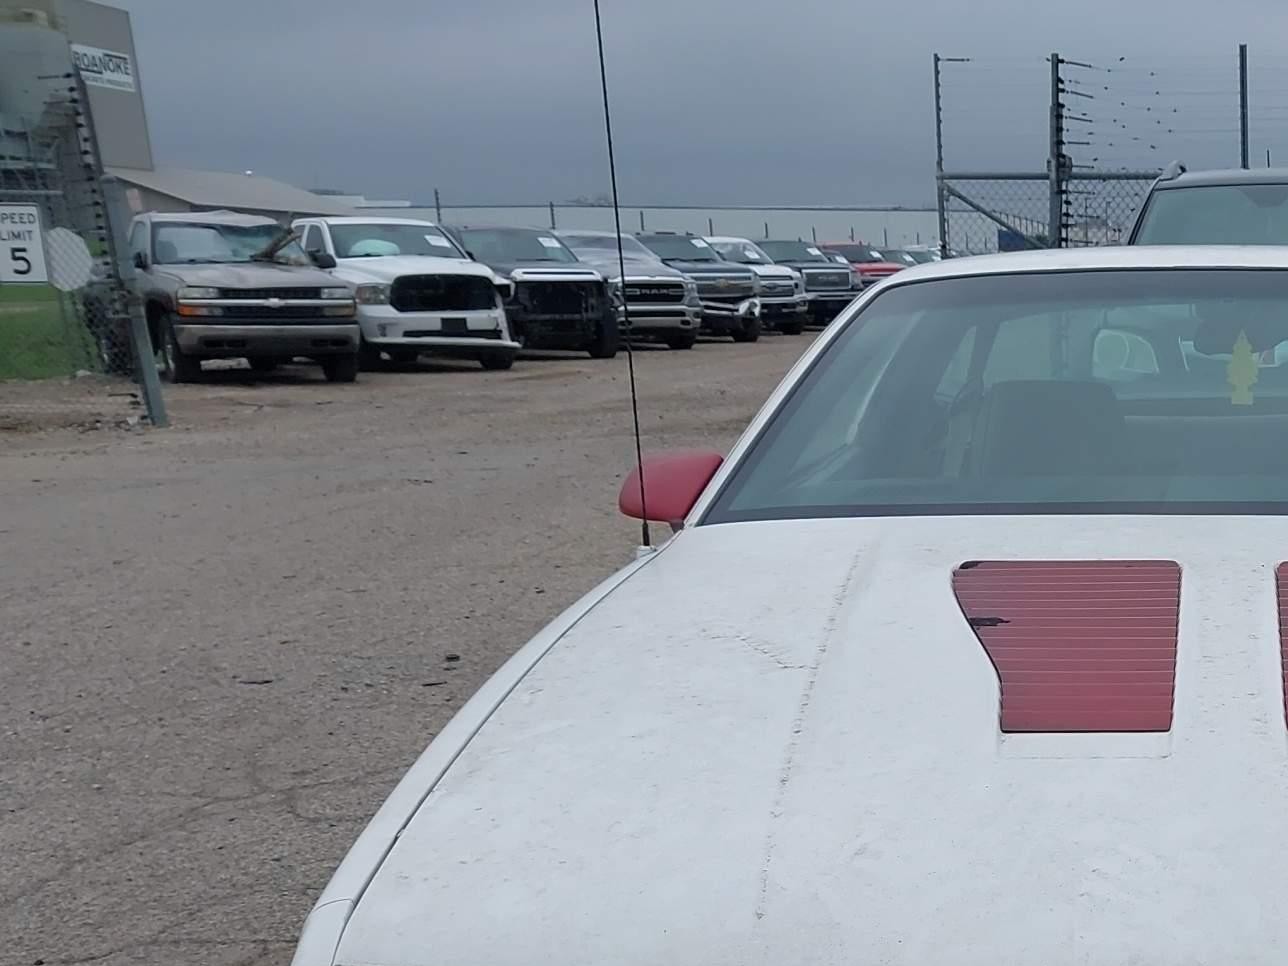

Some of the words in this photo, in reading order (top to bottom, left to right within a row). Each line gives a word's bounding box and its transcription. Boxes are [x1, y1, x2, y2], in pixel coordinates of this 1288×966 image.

[72, 50, 131, 76] ROANOKE
[0, 212, 36, 225] PEED
[0, 230, 33, 242] LIMIT
[10, 246, 32, 276] 5
